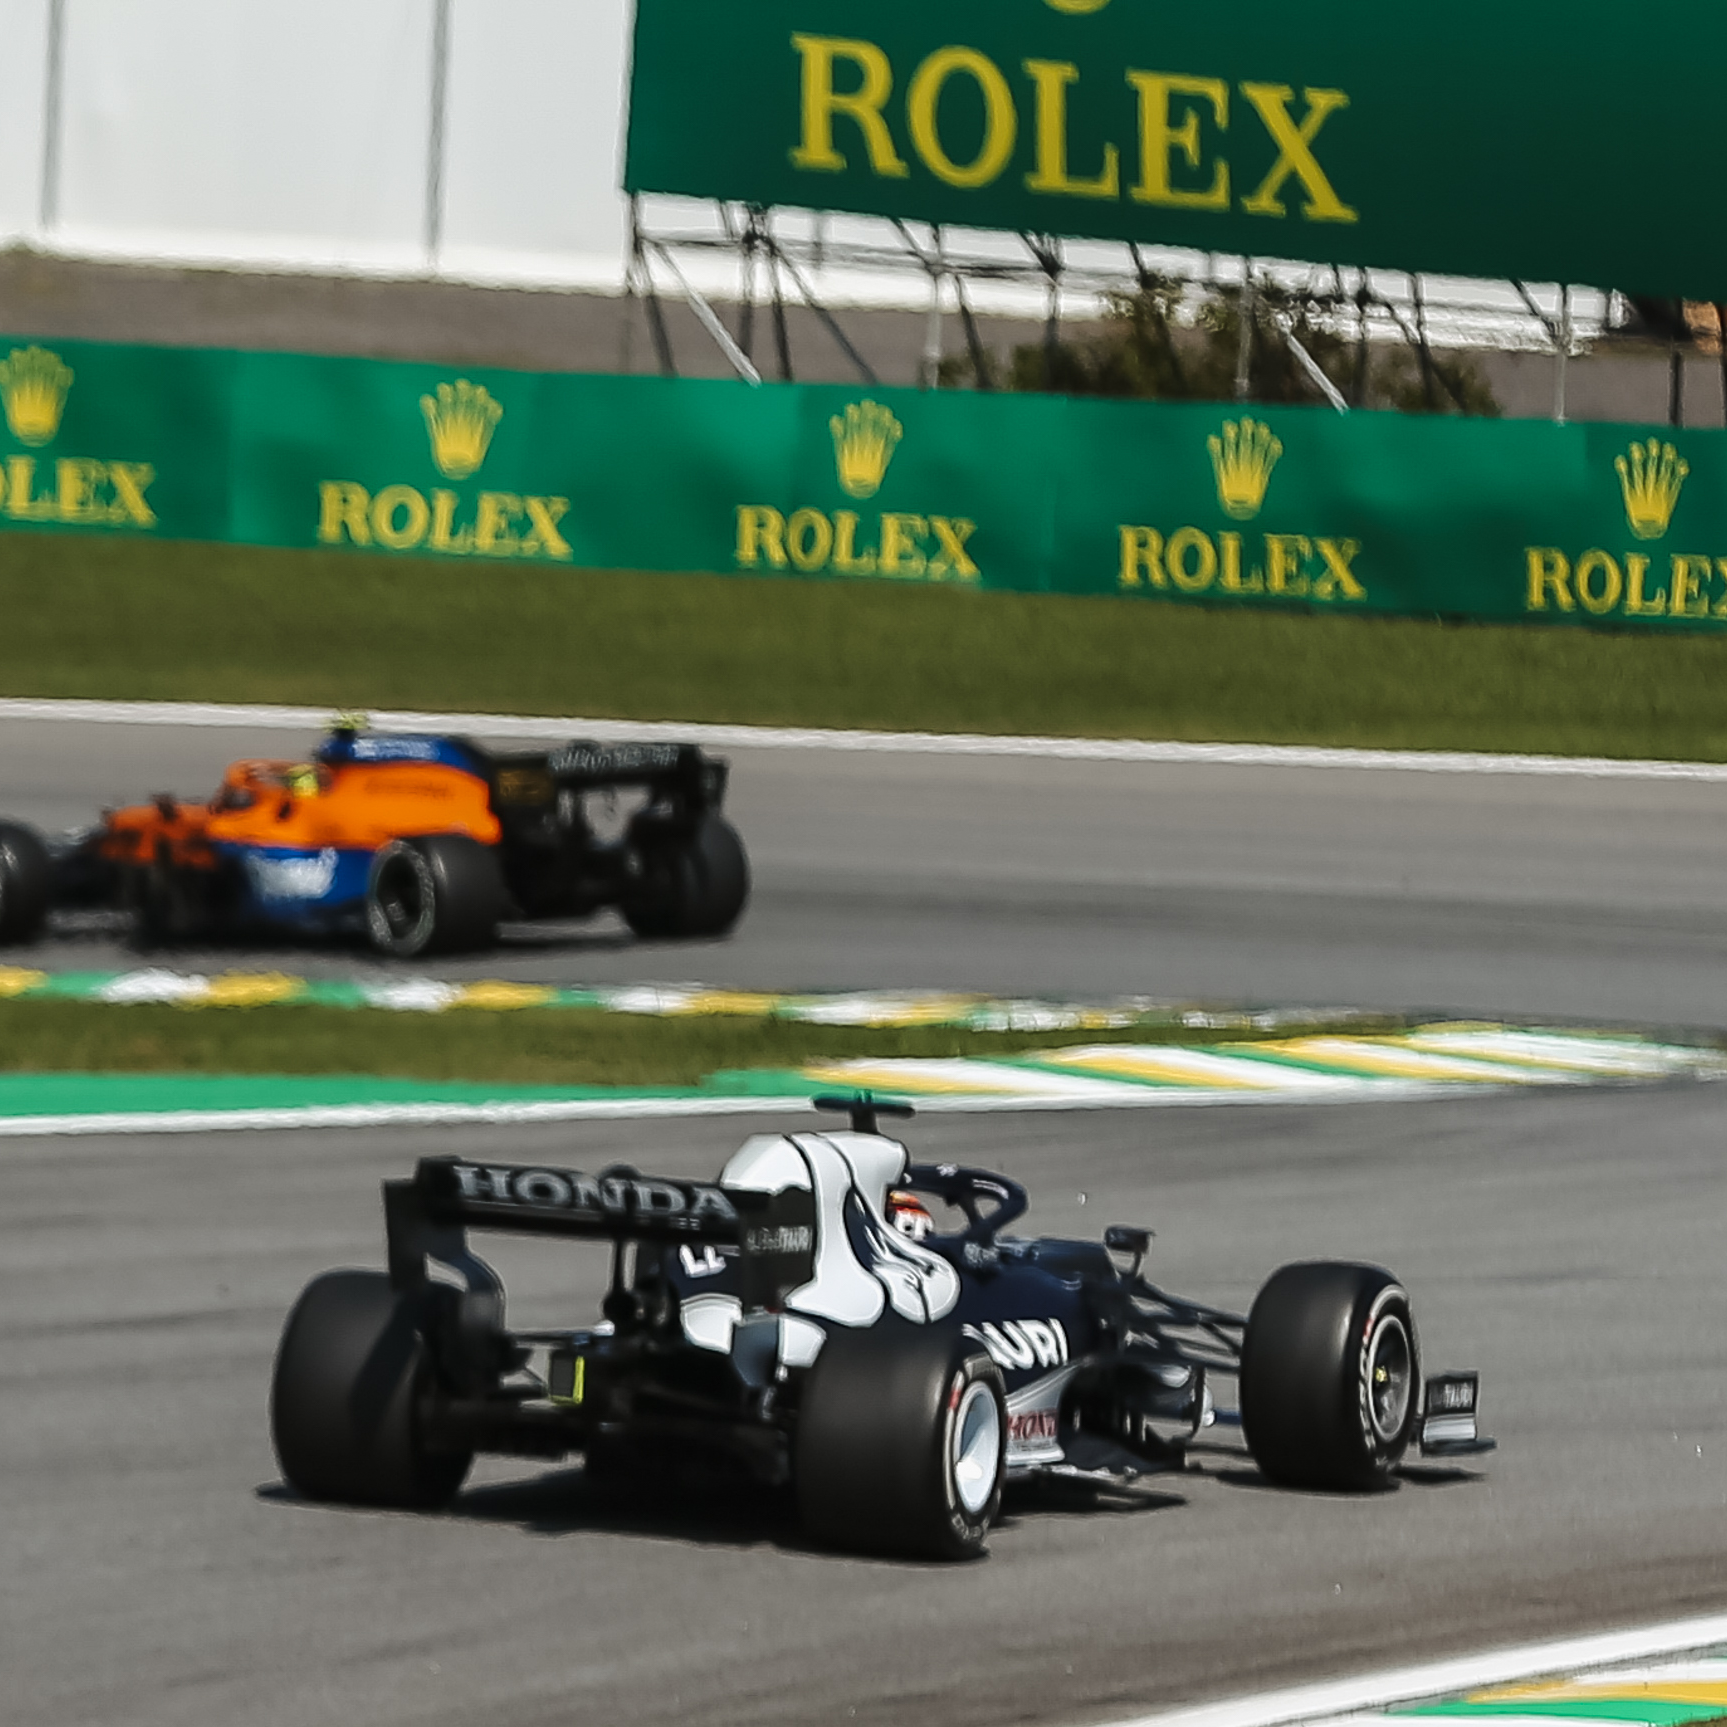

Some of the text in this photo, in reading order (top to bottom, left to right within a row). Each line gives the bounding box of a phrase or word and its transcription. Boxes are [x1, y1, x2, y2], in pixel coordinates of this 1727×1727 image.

[790, 31, 1359, 222] ROLEX
[317, 481, 575, 561] ROLEX
[734, 504, 982, 584] ROLEX
[1117, 524, 1368, 602] ROLEX
[452, 1164, 739, 1219] HONDA
